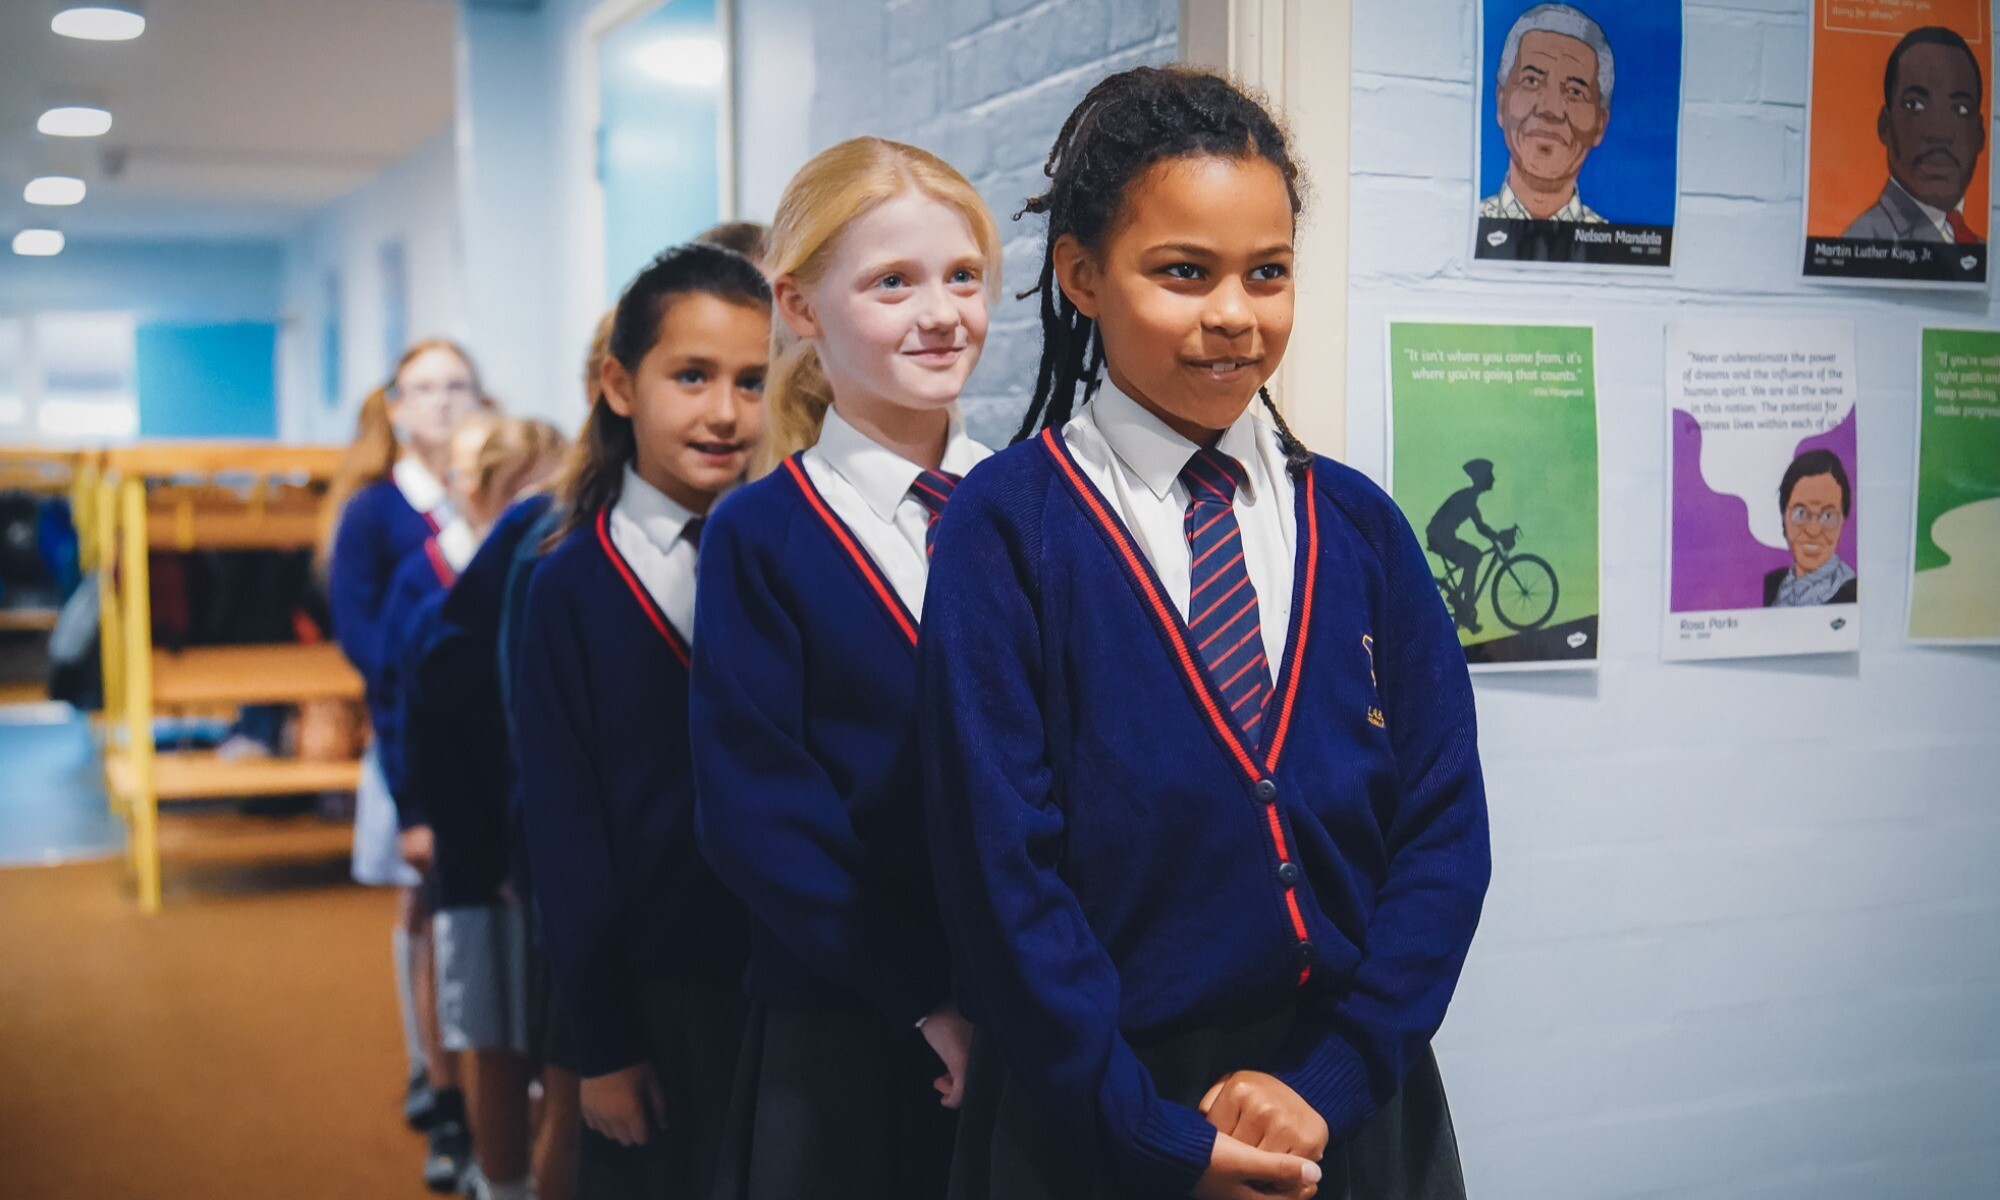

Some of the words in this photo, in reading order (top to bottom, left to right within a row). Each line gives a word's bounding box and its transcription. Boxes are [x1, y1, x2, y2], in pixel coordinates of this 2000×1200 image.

[1574, 229, 1611, 243] Nelson
[1615, 230, 1662, 245] Mandela
[1815, 243, 1851, 256] Martin
[1854, 245, 1888, 259] Luther
[1891, 247, 1918, 264] King,
[1921, 248, 1933, 261] Jr.
[1422, 349, 1445, 362] isn't
[1447, 350, 1479, 363] where
[1482, 352, 1503, 366] you
[1505, 352, 1533, 363] come
[1567, 351, 1582, 364] it's
[1687, 352, 1719, 363] "Never
[1721, 351, 1788, 363] underestimate
[1791, 351, 1806, 362] the
[1809, 353, 1836, 364] power
[1412, 368, 1445, 380] where
[1448, 368, 1481, 384] you're
[1483, 369, 1513, 384] going
[1515, 368, 1537, 381] that
[1682, 368, 1692, 382] of
[1694, 369, 1730, 380] dreams
[1732, 369, 1751, 380] and
[1754, 369, 1769, 380] the
[1771, 368, 1813, 382] influence
[1816, 368, 1826, 382] of
[1828, 368, 1843, 379] the
[1683, 386, 1718, 397] human
[1721, 386, 1746, 399] spirit.
[1751, 386, 1766, 396] We
[1769, 386, 1784, 396] are
[1787, 385, 1799, 396] all
[1801, 385, 1816, 396] the
[1820, 386, 1843, 396] same
[1691, 402, 1700, 413] in
[1703, 402, 1722, 413] this
[1760, 401, 1777, 412] The
[1781, 401, 1823, 414] potential
[1825, 400, 1837, 414] for
[1733, 419, 1754, 430] lives
[1757, 418, 1789, 430] within
[1791, 417, 1813, 429] each
[1816, 417, 1826, 431] of
[1680, 619, 1705, 630] Rosa
[1709, 617, 1739, 629] Parks
